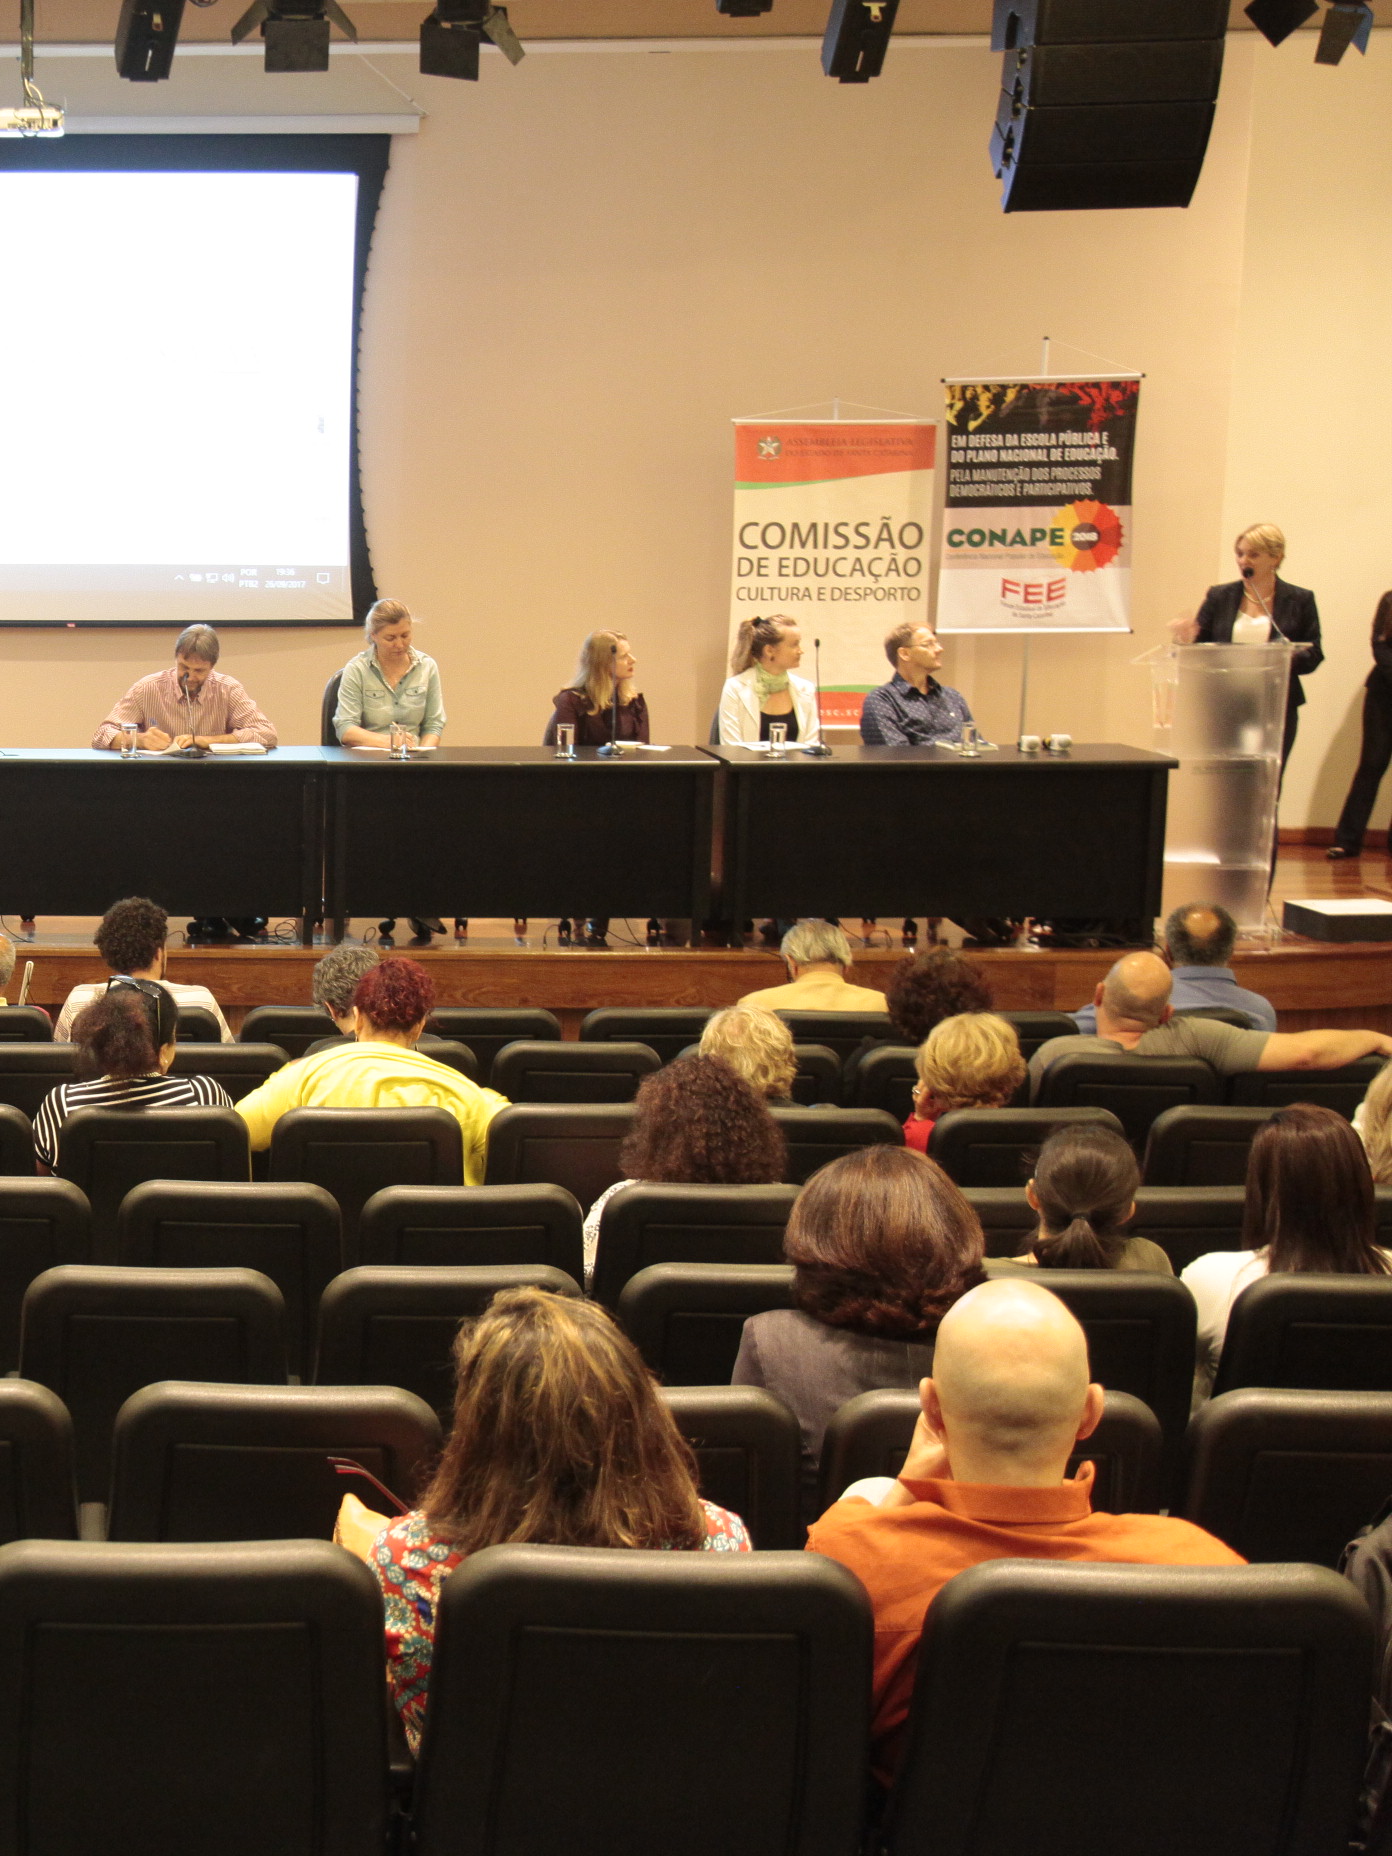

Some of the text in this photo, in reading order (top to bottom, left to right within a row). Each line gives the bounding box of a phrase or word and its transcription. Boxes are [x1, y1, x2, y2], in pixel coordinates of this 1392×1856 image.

[951, 429, 1109, 447] EM DEFESA DA ESCOLA PÚBLICA E
[950, 444, 1120, 464] DO PLANO NACIONAL DE EDUCAÇÃO.
[949, 465, 1102, 484] PELA MANUTENÇÃO DOS PROCESSOS
[949, 482, 1094, 497] DEMOCRÁTICOS E PARTICIPATIVOS.
[738, 515, 924, 550] COMISSÃO
[947, 527, 1065, 548] CONAPE
[1071, 532, 1099, 542] 2018
[736, 552, 923, 584] DE EDUCAÇÃO
[736, 586, 922, 602] CULTURA E DESPORTO
[1002, 577, 1066, 603] FEE
